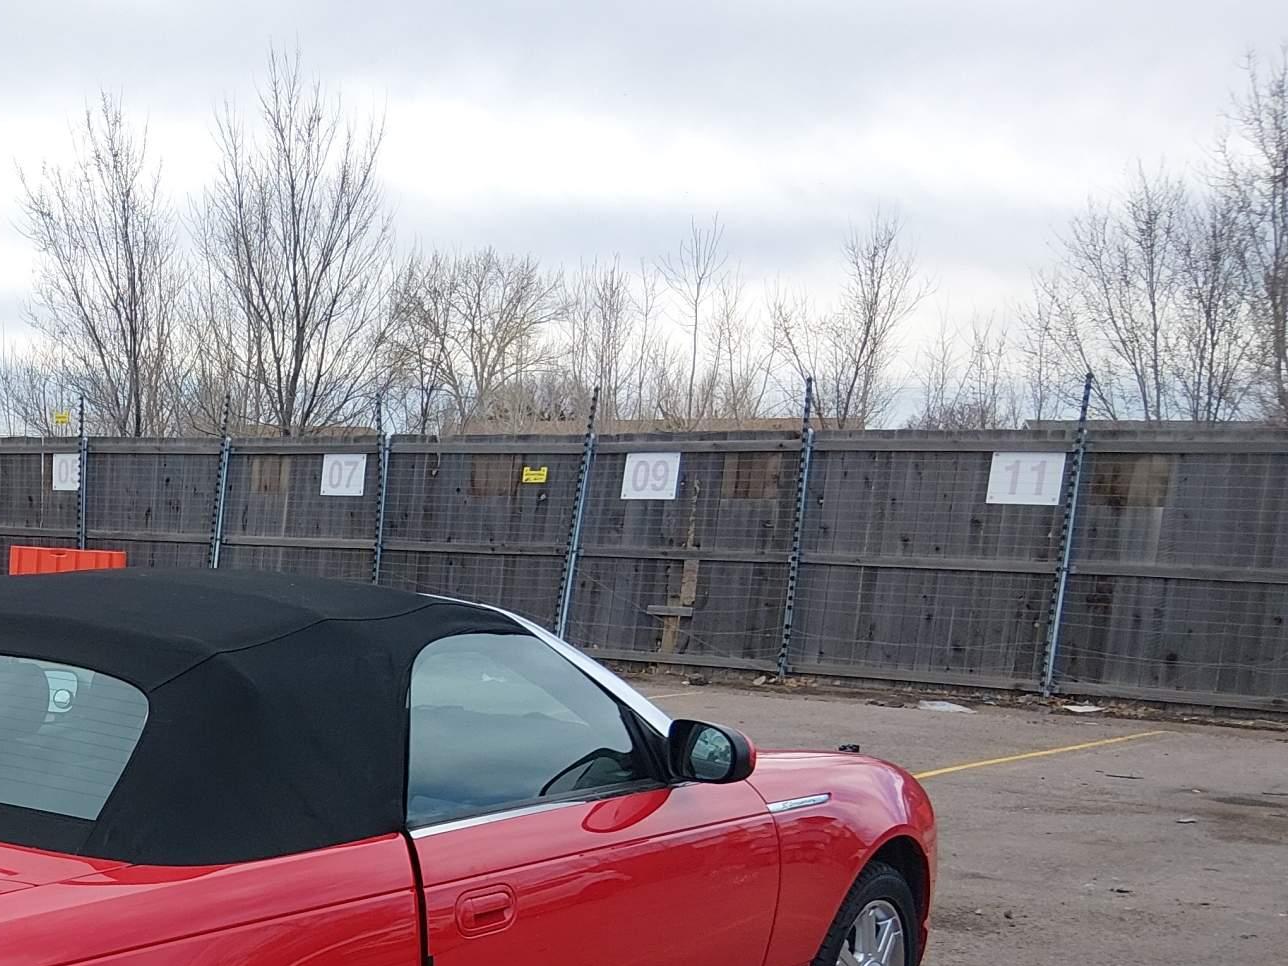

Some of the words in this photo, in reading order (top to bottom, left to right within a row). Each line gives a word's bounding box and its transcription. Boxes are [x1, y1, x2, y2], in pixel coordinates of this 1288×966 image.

[328, 460, 361, 489] 07
[631, 459, 670, 492] 09
[1004, 459, 1048, 496] 11
